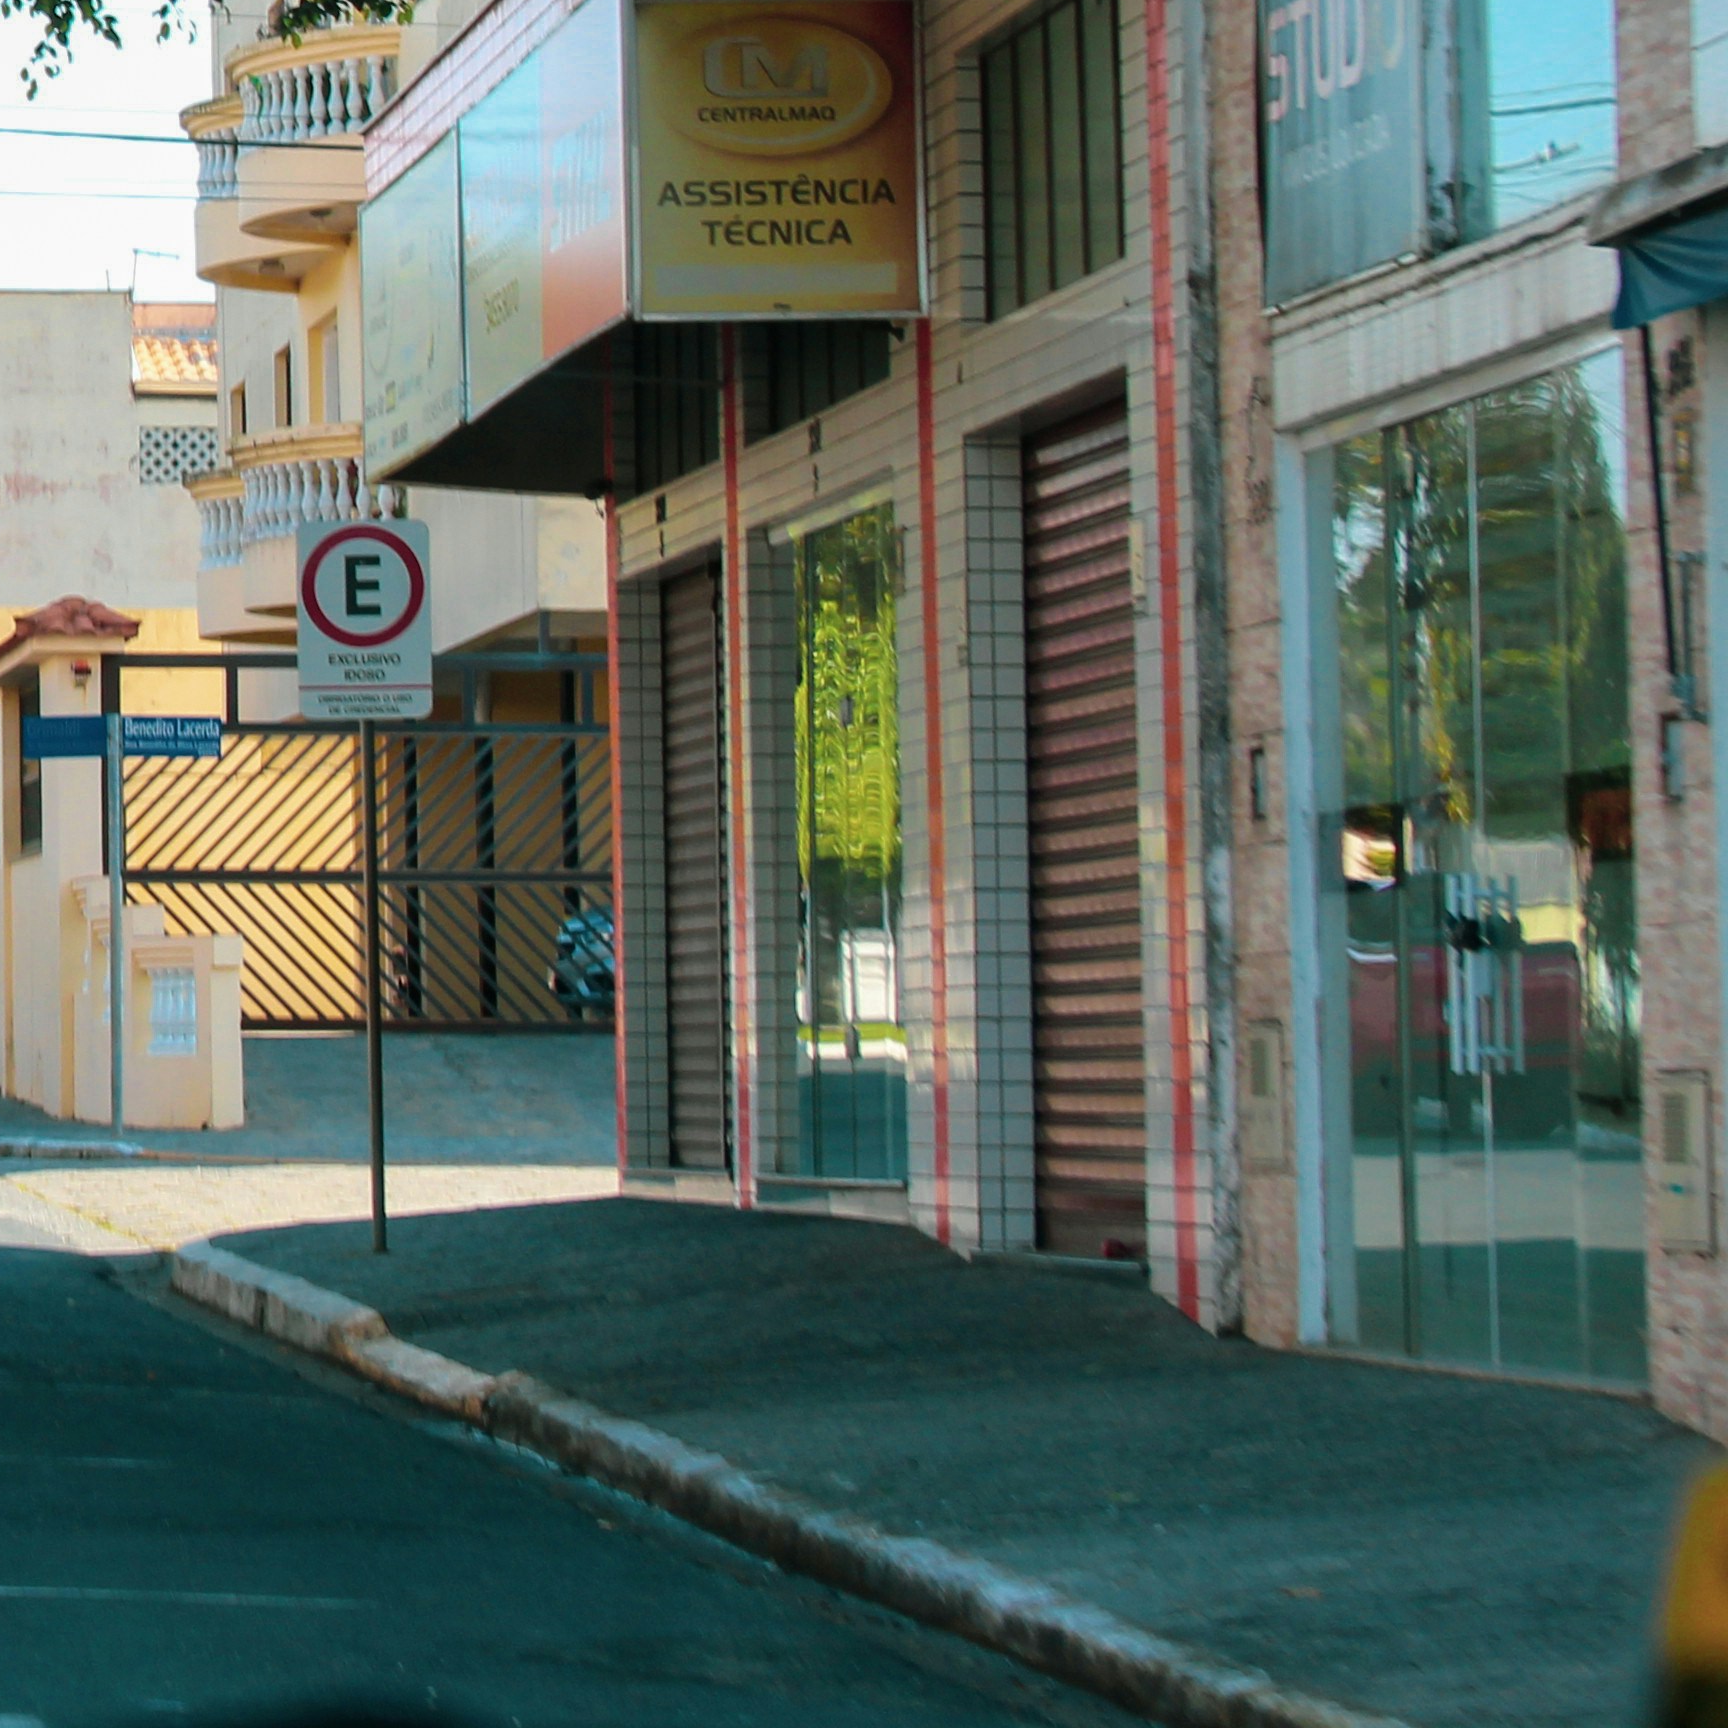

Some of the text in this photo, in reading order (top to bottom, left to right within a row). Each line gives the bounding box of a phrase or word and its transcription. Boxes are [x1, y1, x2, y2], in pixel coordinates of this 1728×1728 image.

[698, 104, 836, 123] CENTRALMAQ
[657, 174, 896, 207] ASSISTÊNCIA
[700, 214, 853, 247] TÉCNICA
[344, 554, 382, 616] E
[328, 653, 401, 666] EXCLUSIVO
[344, 668, 386, 682] IDOSO
[124, 717, 220, 739] Benedito Lacerda
